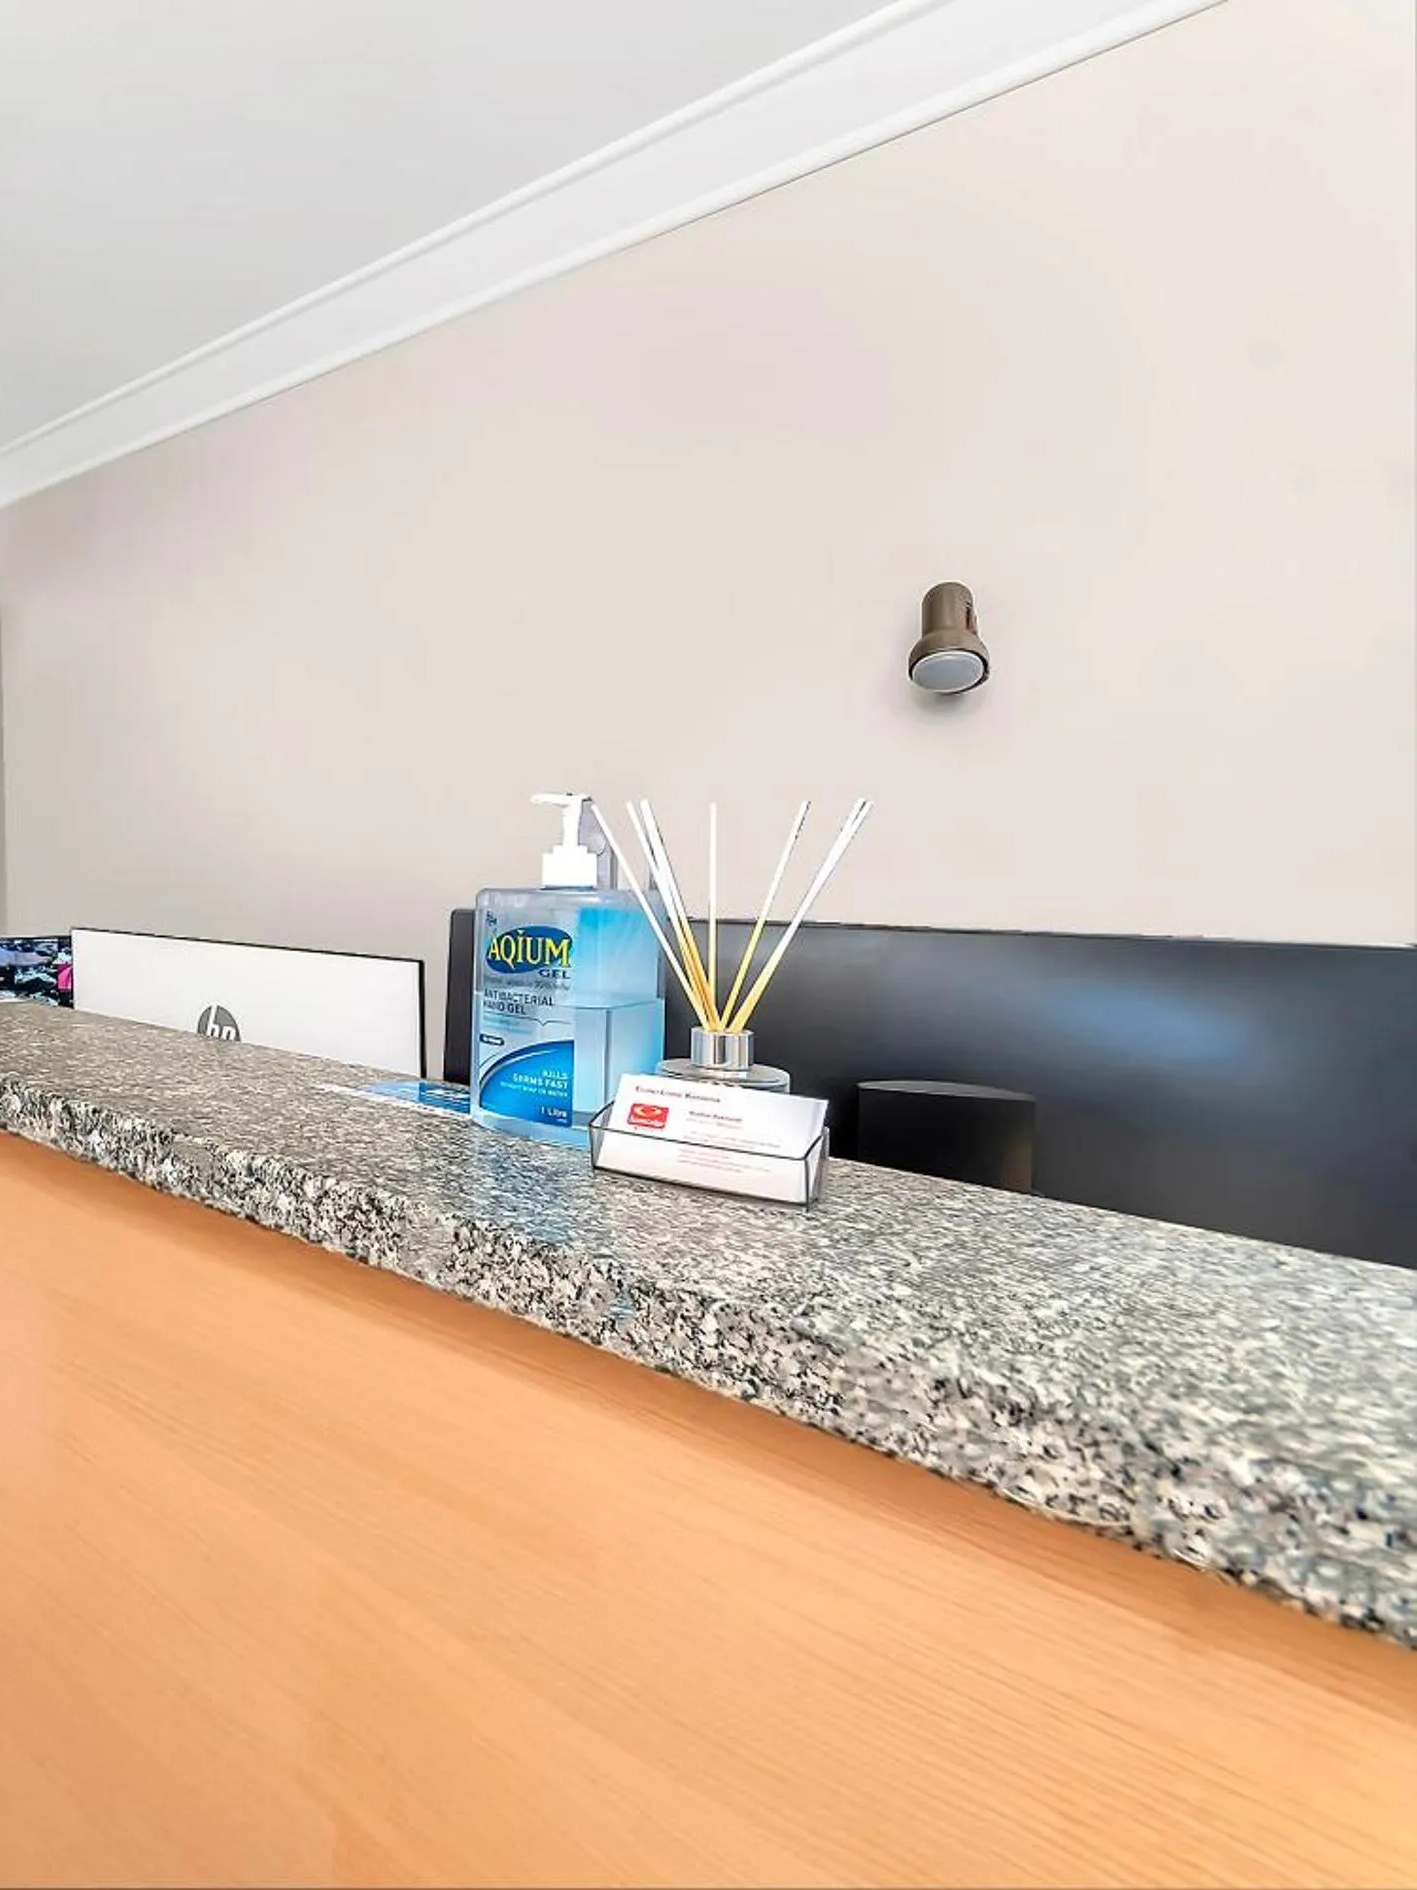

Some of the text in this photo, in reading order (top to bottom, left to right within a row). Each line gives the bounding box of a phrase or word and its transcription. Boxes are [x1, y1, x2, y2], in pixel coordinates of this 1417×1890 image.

[538, 968, 571, 979] GEL
[484, 988, 554, 1006] ANTIBACTERIAL
[483, 1000, 527, 1015] HAND GEL
[513, 1073, 568, 1090] GERMS FAST
[542, 1070, 568, 1079] KILLS
